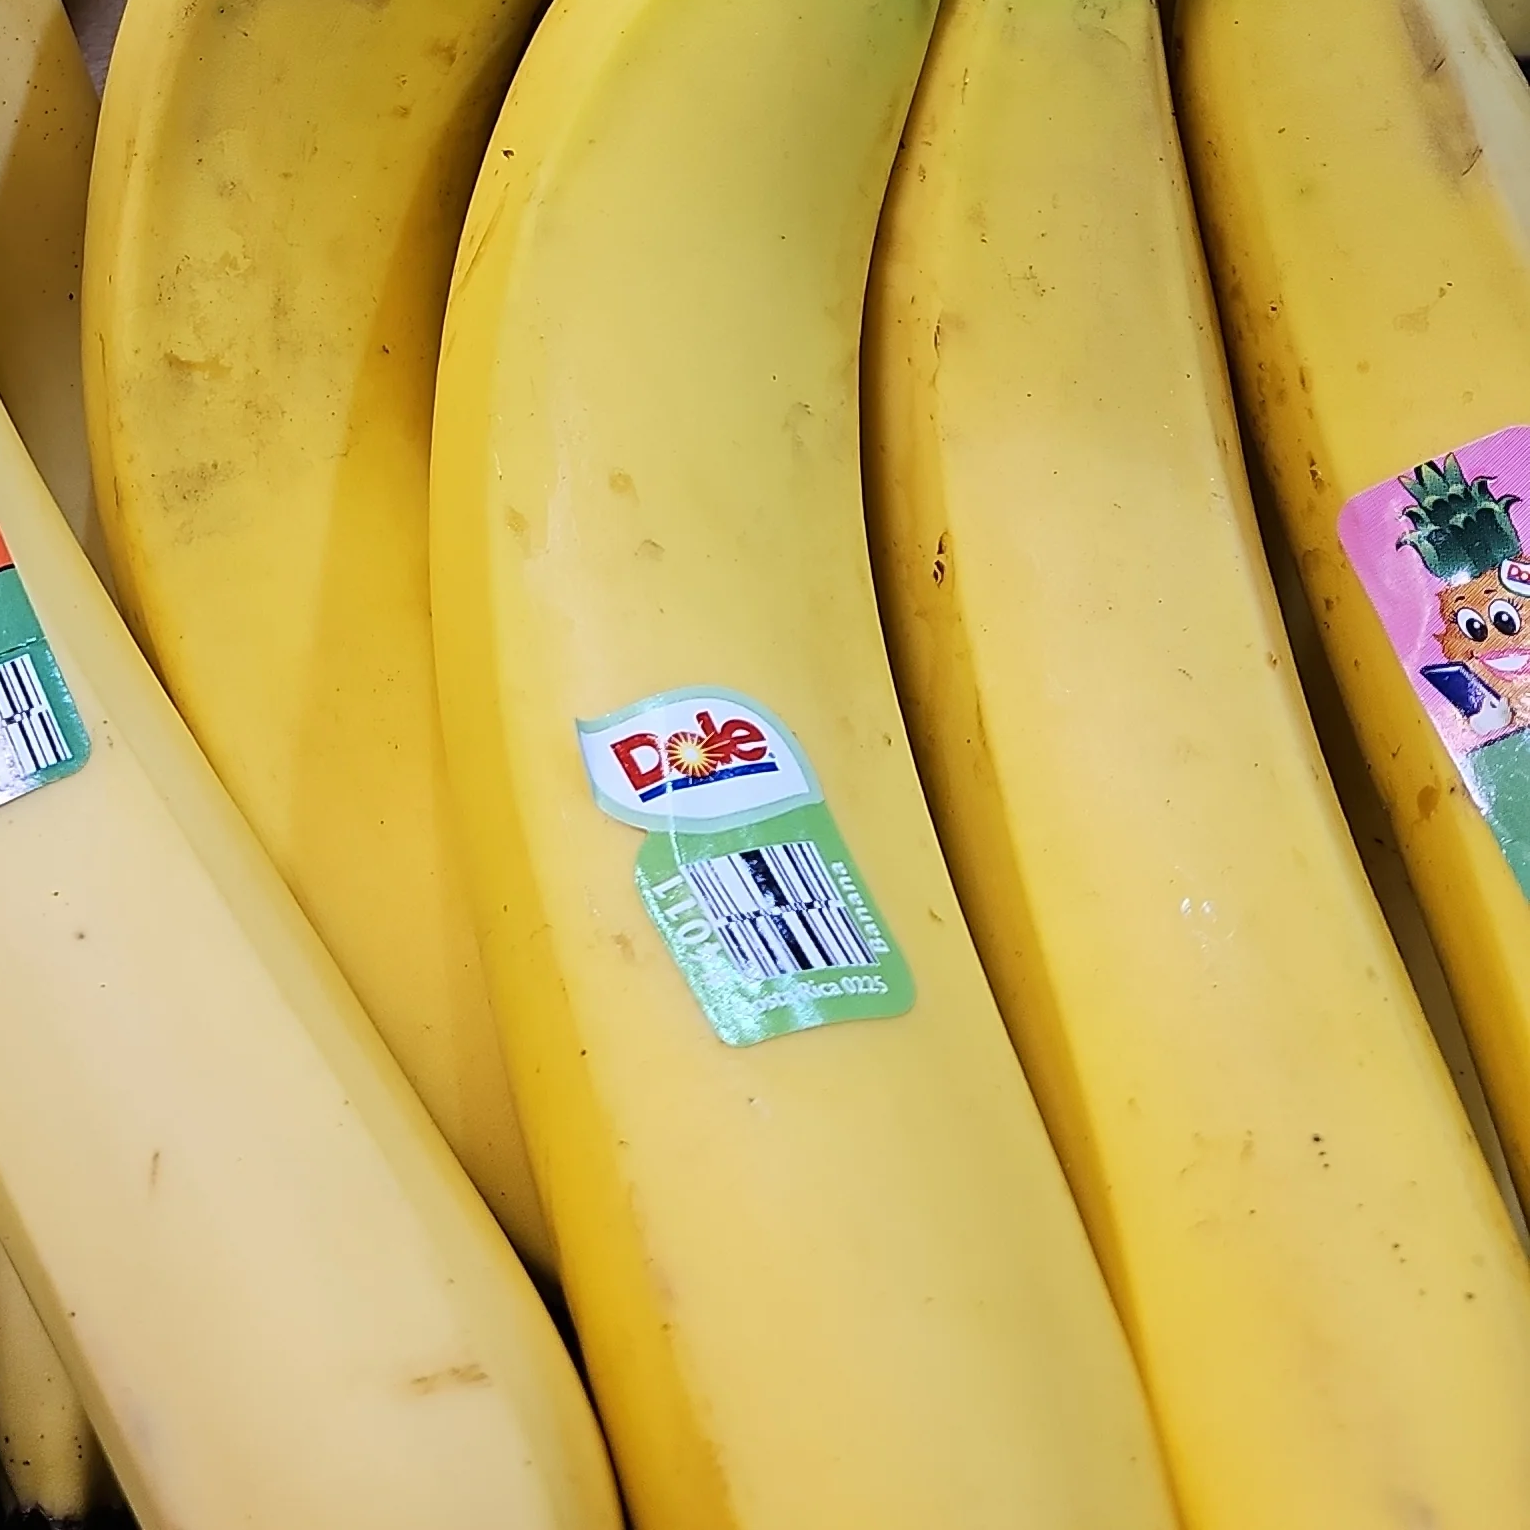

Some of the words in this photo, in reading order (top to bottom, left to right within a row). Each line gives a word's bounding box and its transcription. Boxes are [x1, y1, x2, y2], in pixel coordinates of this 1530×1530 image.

[610, 710, 768, 791] Dole
[830, 861, 890, 955] Banana
[841, 975, 889, 995] 0225
